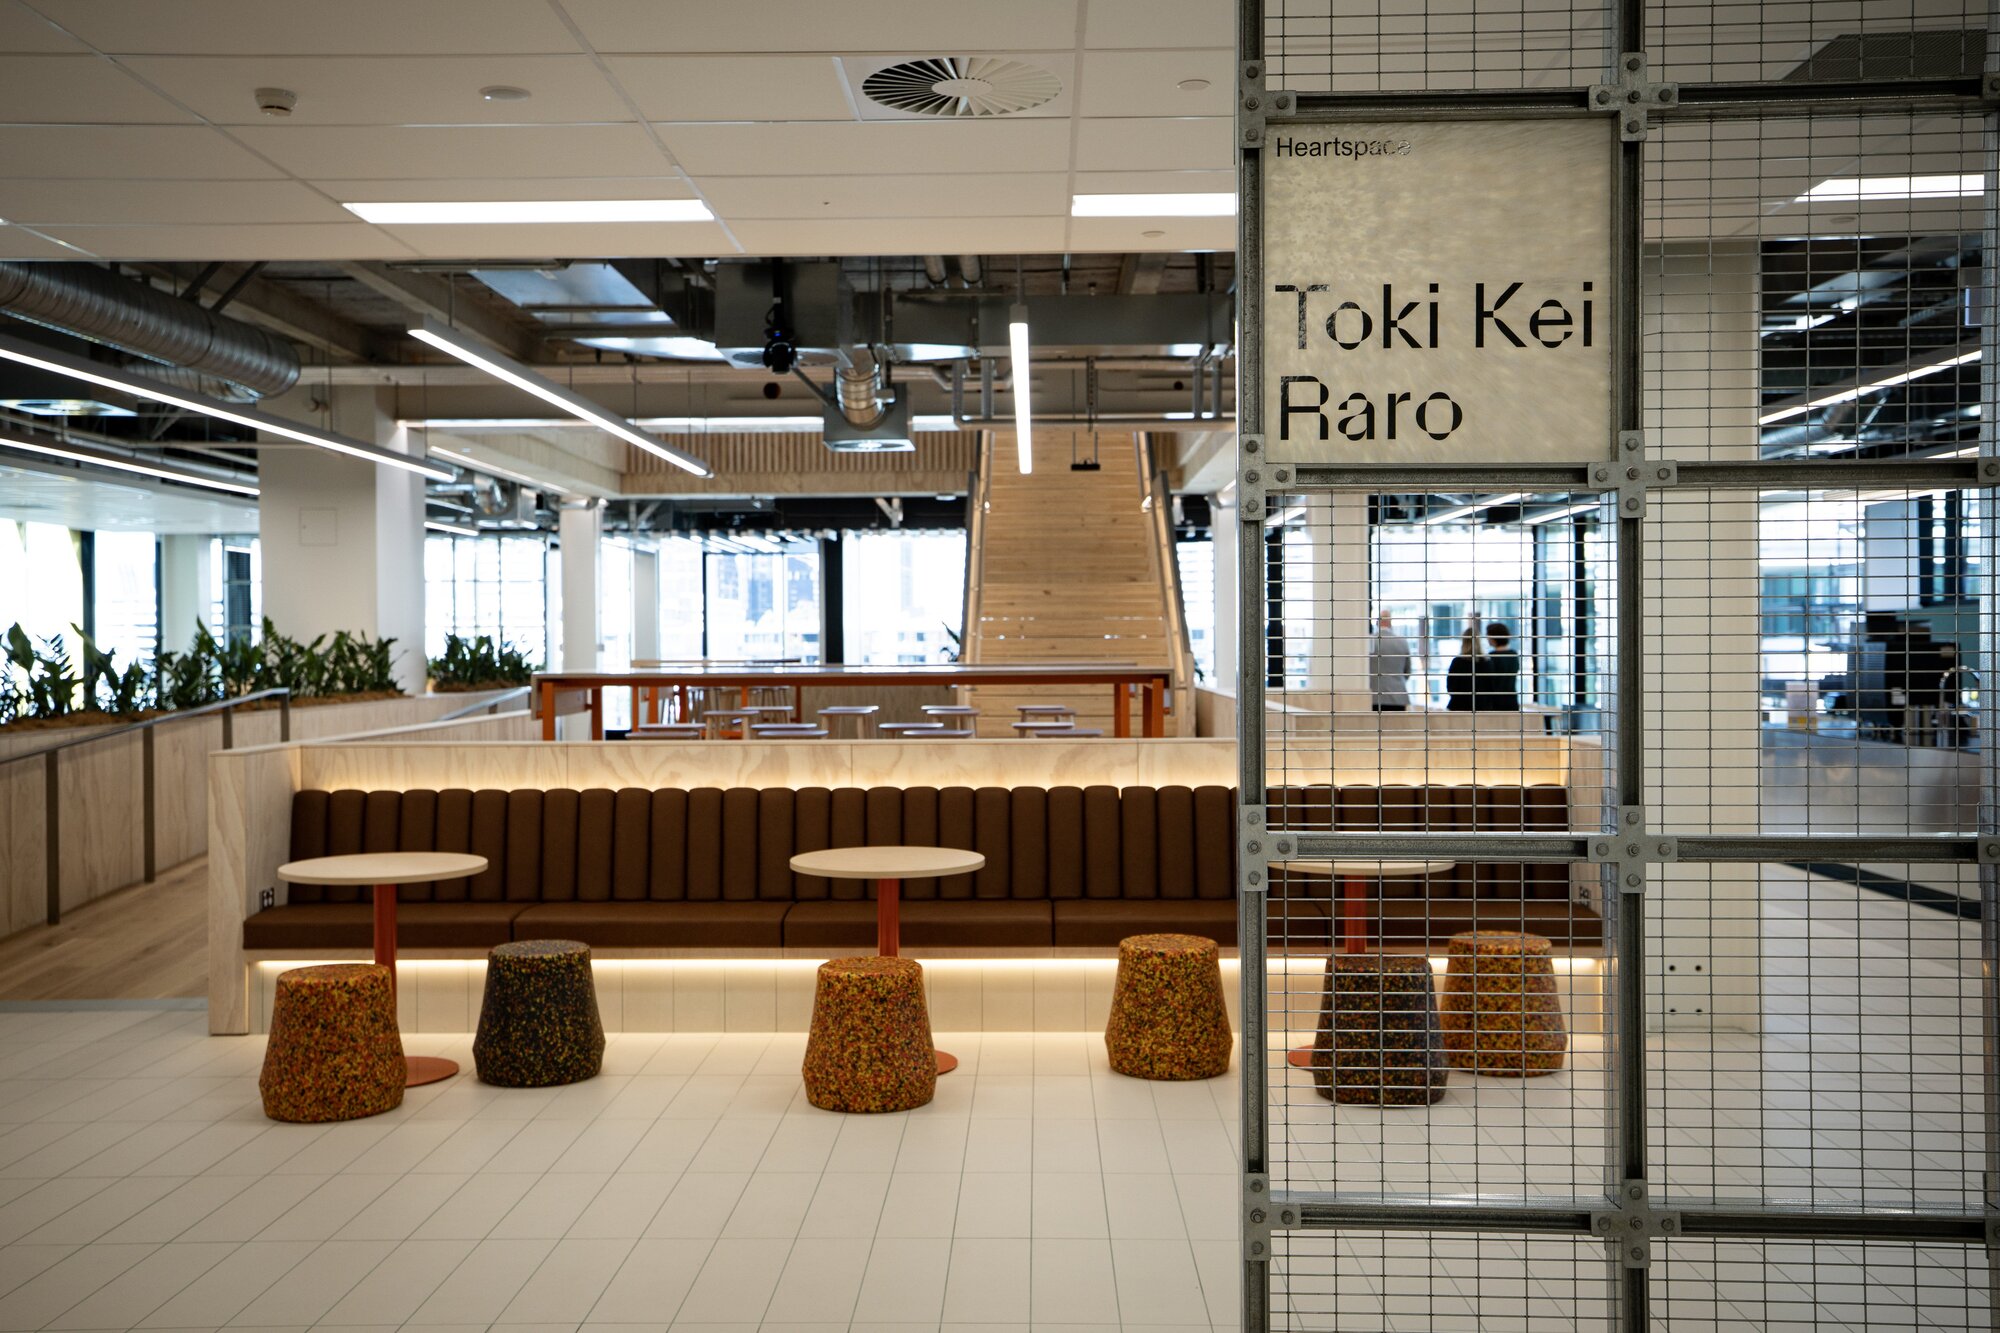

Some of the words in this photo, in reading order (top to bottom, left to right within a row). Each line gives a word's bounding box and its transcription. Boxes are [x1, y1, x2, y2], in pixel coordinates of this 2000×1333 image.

[1276, 137, 1412, 161] Heartspace
[1274, 282, 1439, 351] Toki
[1475, 281, 1593, 349] Kei
[1280, 375, 1463, 441] Raro
